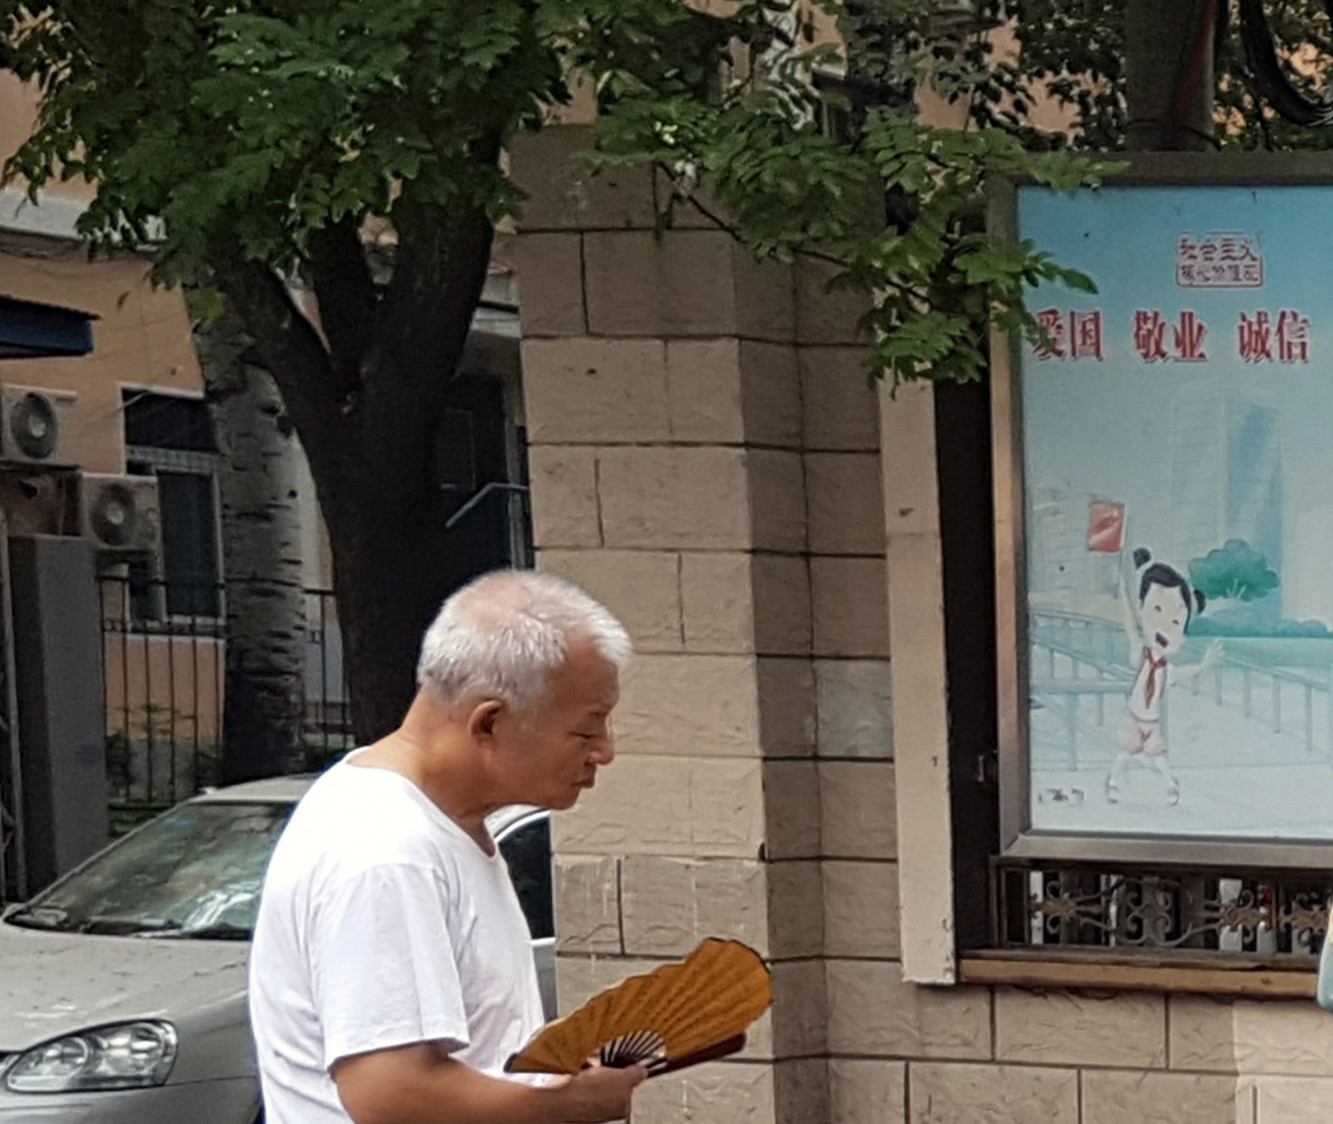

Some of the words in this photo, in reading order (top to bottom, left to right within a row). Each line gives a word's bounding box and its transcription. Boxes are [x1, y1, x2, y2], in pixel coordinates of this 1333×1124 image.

[1033, 308, 1103, 361] 爱国
[1134, 309, 1209, 363] 敬业
[1237, 309, 1311, 363] 诚信
